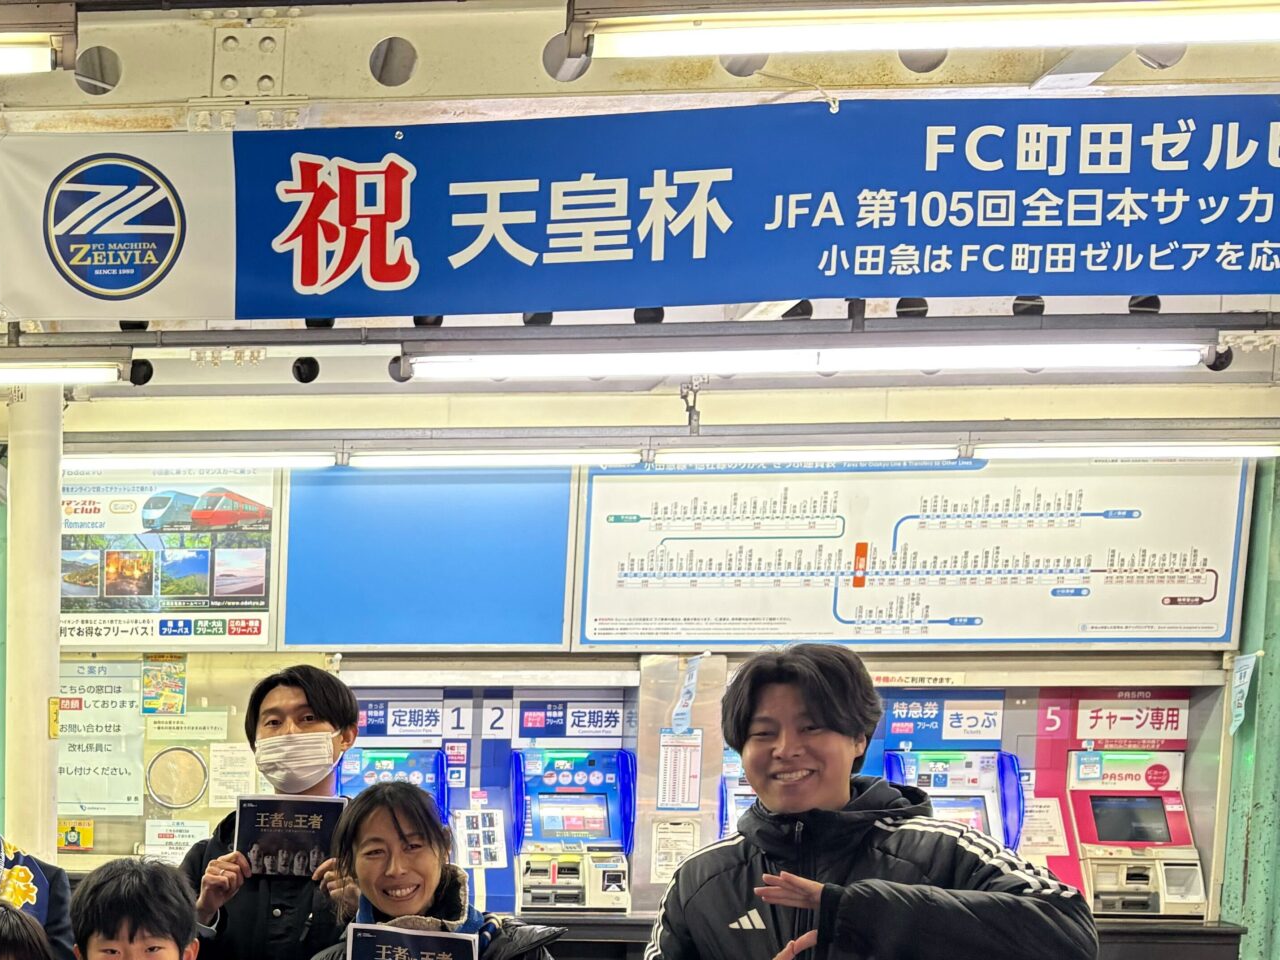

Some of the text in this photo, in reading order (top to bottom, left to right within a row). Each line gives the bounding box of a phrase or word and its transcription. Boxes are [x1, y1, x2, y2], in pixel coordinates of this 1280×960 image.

[447, 167, 734, 271] 天皇杯
[765, 192, 845, 231] JFA
[273, 153, 419, 294] 祝
[69, 244, 159, 265] ZELVIA
[108, 242, 157, 250] MACHIDA
[60, 684, 122, 695] こちらの窓口は
[391, 708, 440, 728] 定期券
[451, 706, 465, 730] 1
[489, 706, 505, 730] 2
[571, 710, 620, 728] 定期券
[892, 701, 939, 719] 特急券
[949, 711, 997, 729] きっぷ
[1045, 706, 1061, 731] 5
[1089, 707, 1180, 731] チャージ専用
[60, 723, 121, 733] お問い合わせは
[916, 721, 939, 730] フリーパス
[1102, 773, 1142, 782] PASMO
